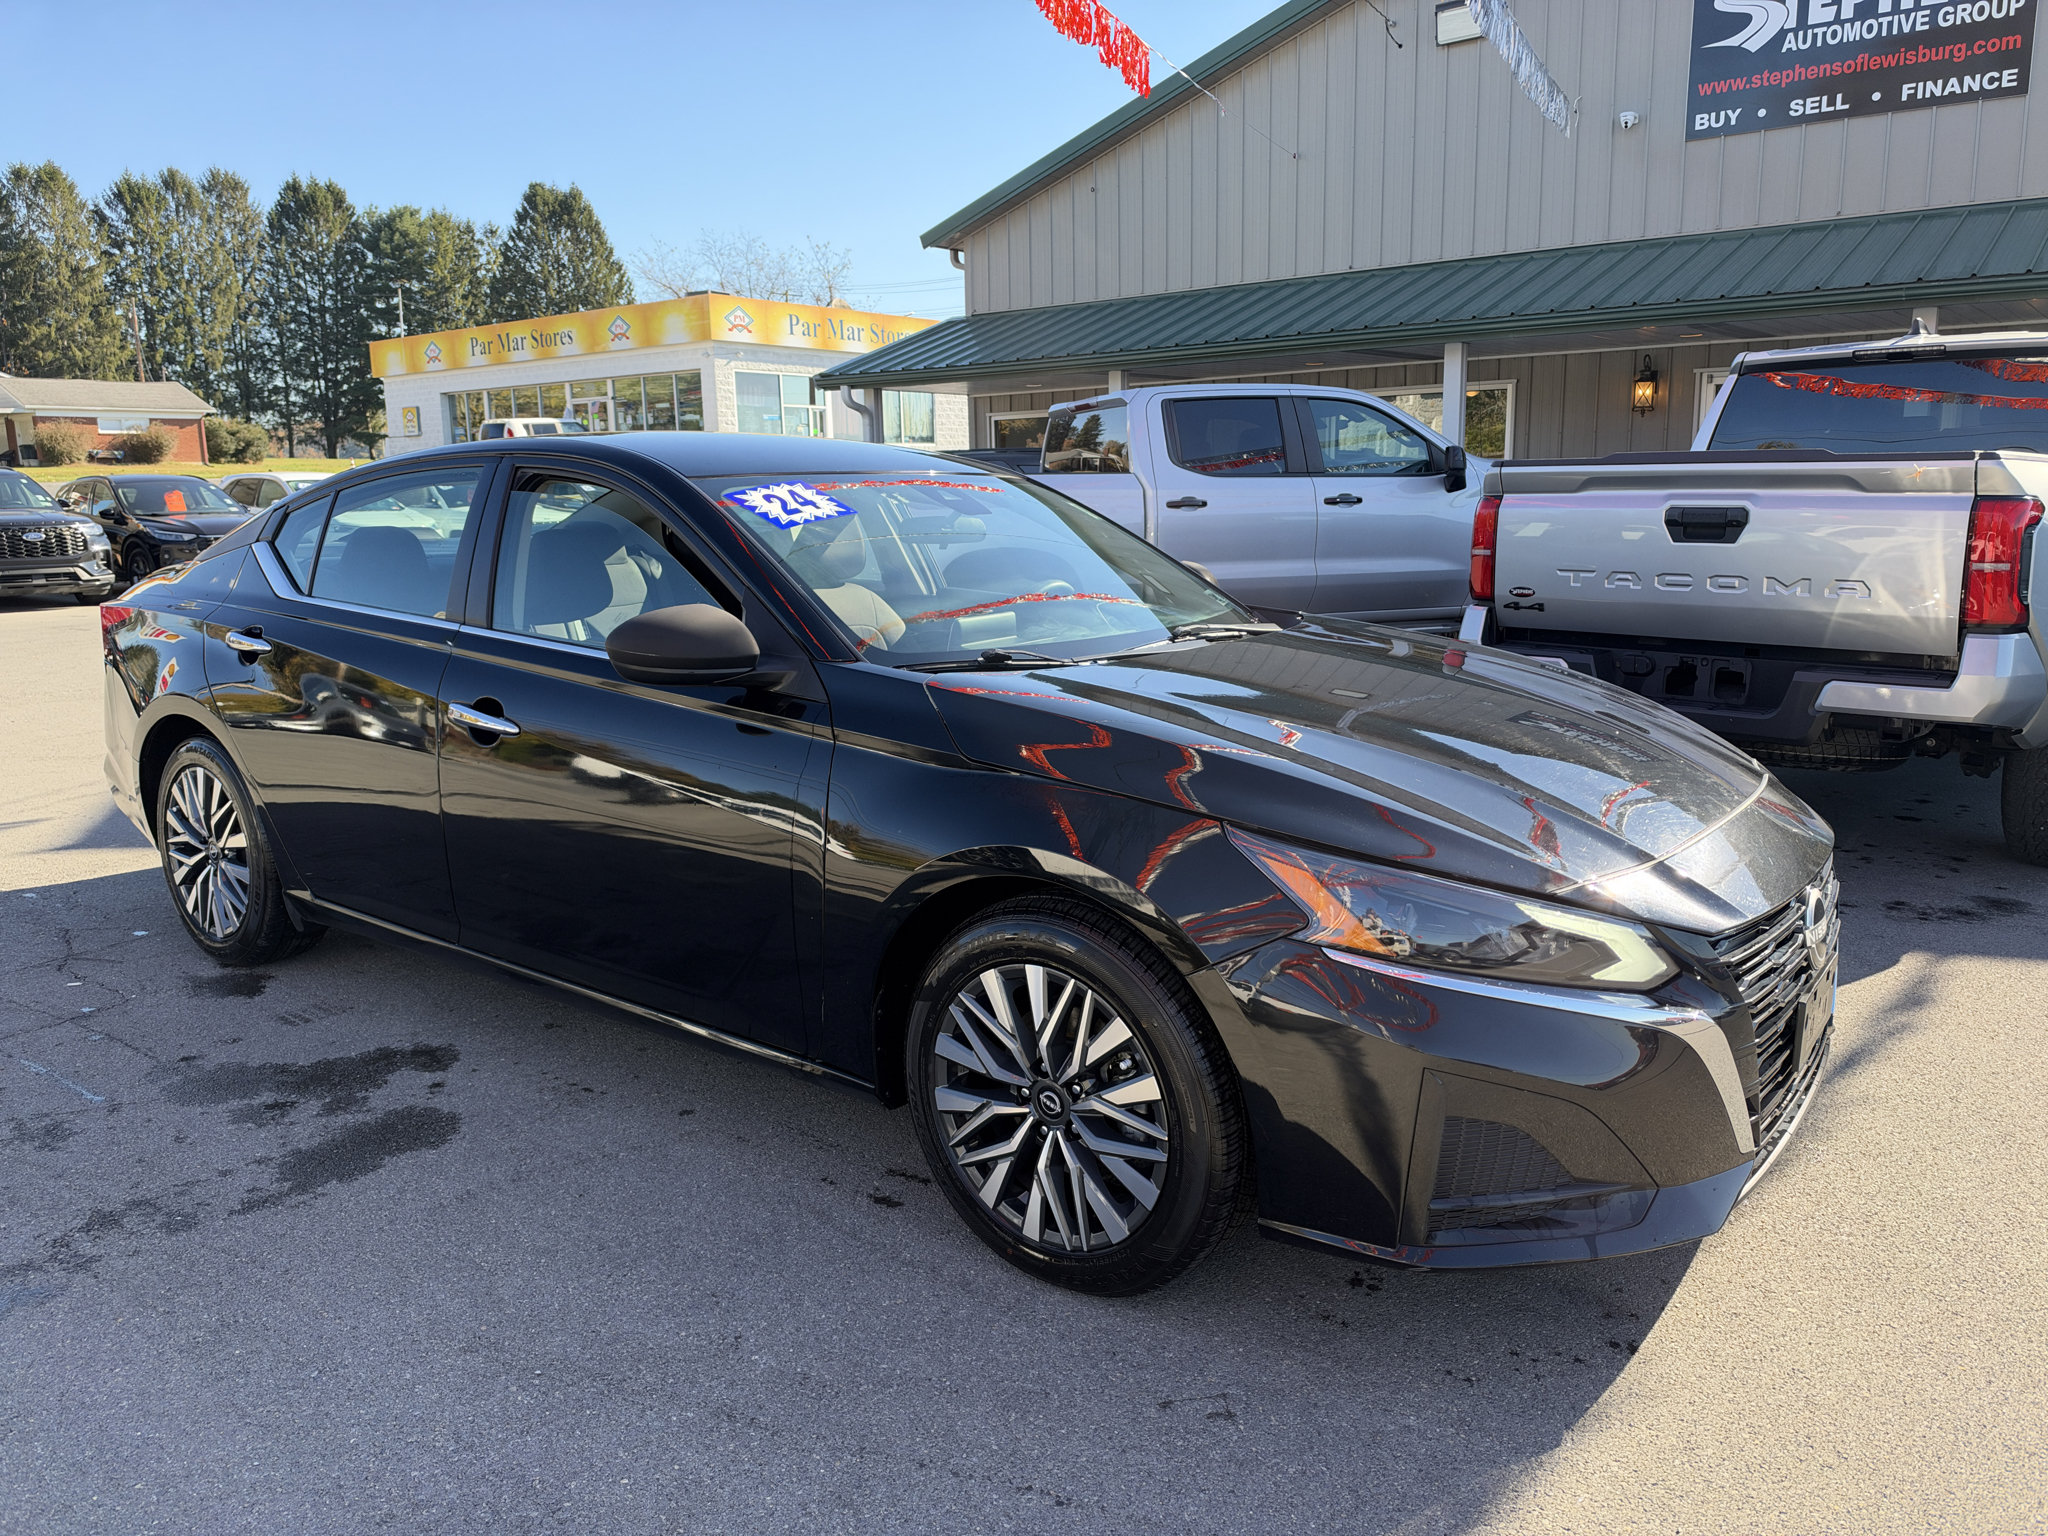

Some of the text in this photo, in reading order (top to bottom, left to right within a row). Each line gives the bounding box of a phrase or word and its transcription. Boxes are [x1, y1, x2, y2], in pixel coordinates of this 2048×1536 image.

[1781, 10, 1930, 53] AUTOMOTIVE
[1937, 0, 2026, 28] GROUP
[1698, 34, 2022, 97] www.stephensoflewisburg.com
[1694, 69, 2019, 131] BUY SELL FINANCE
[470, 328, 574, 357] Par Mar Stores
[787, 313, 910, 344] Par Mar Stor
[761, 488, 822, 516] 24
[1555, 567, 1872, 600] TACOMA
